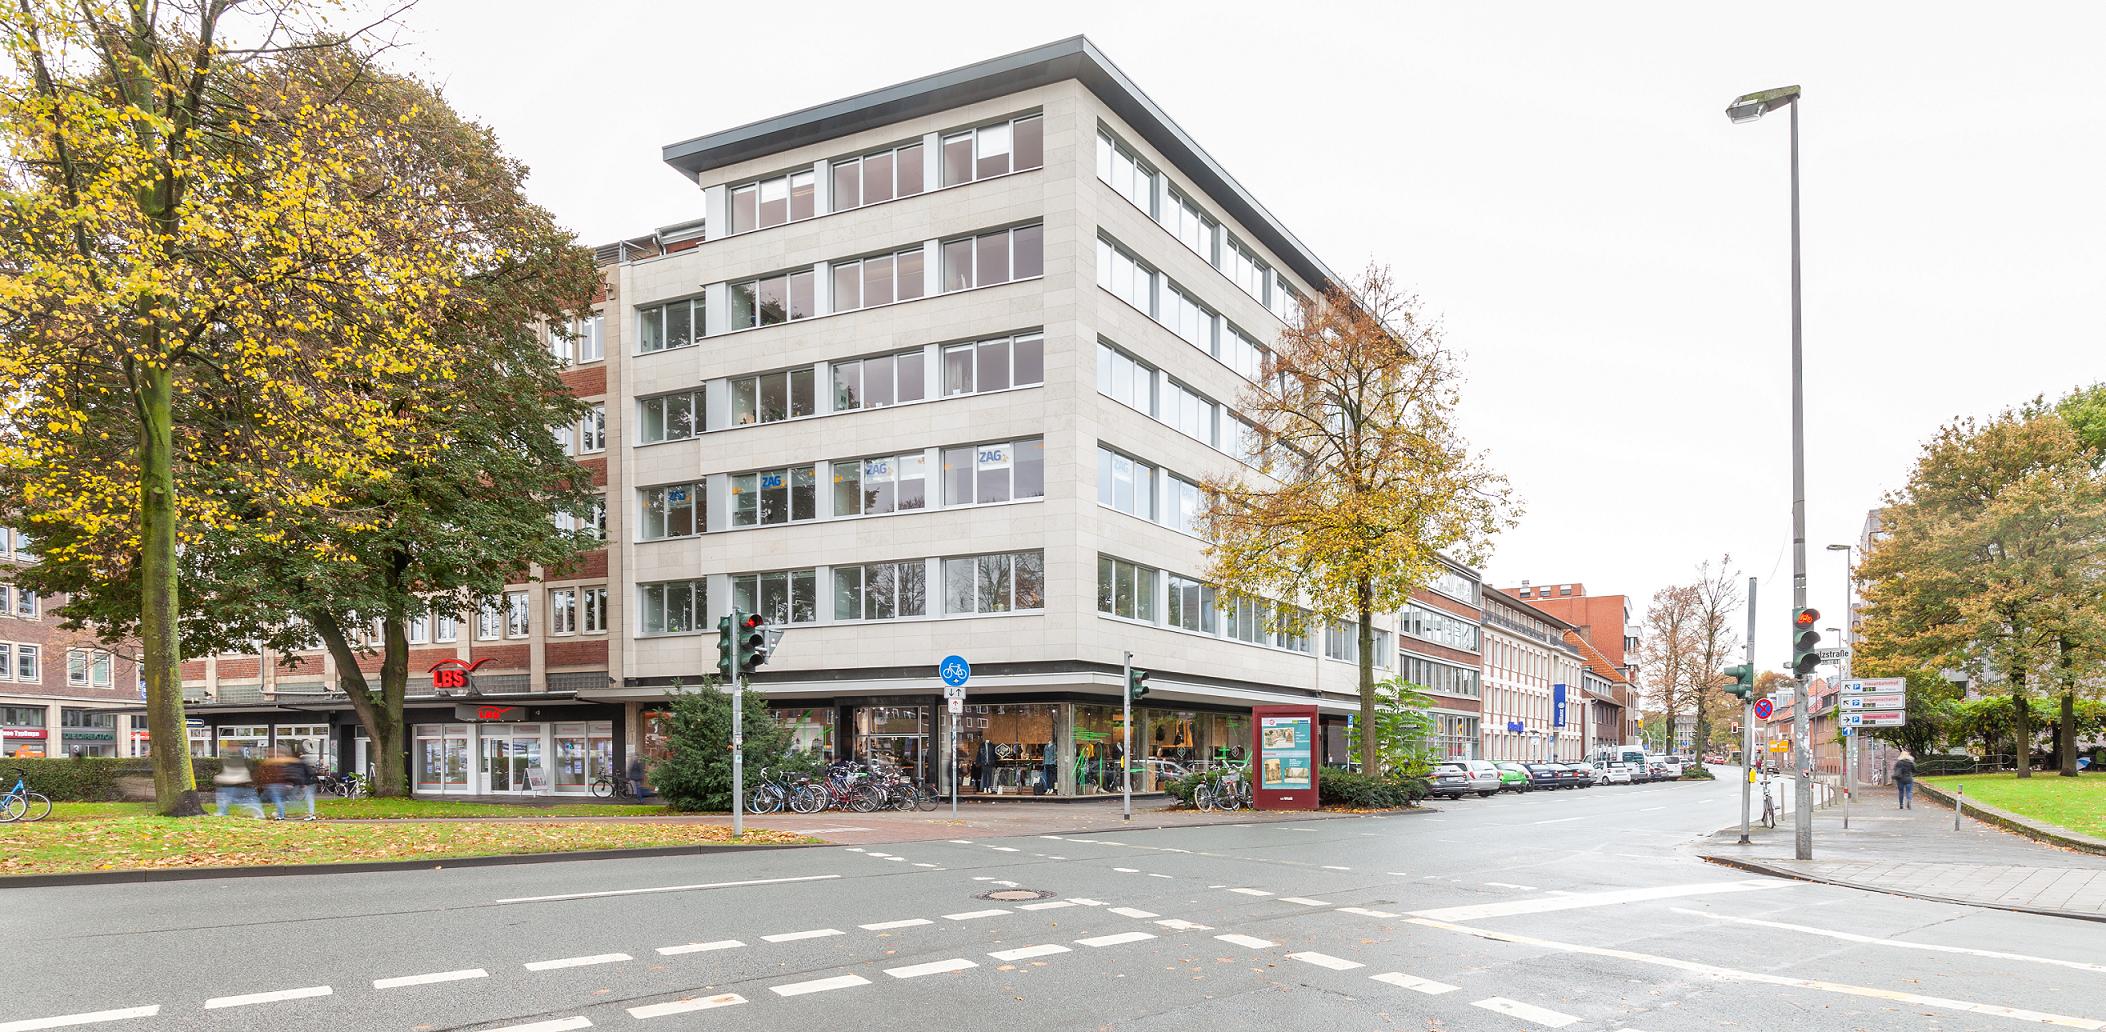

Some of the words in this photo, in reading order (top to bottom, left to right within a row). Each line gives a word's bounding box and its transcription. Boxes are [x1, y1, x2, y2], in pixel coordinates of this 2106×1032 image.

[979, 450, 1001, 462] ZAG
[866, 463, 887, 475] ZAG
[762, 475, 781, 489] ZAG
[433, 669, 466, 689] LBS
[479, 711, 501, 720] LBS
